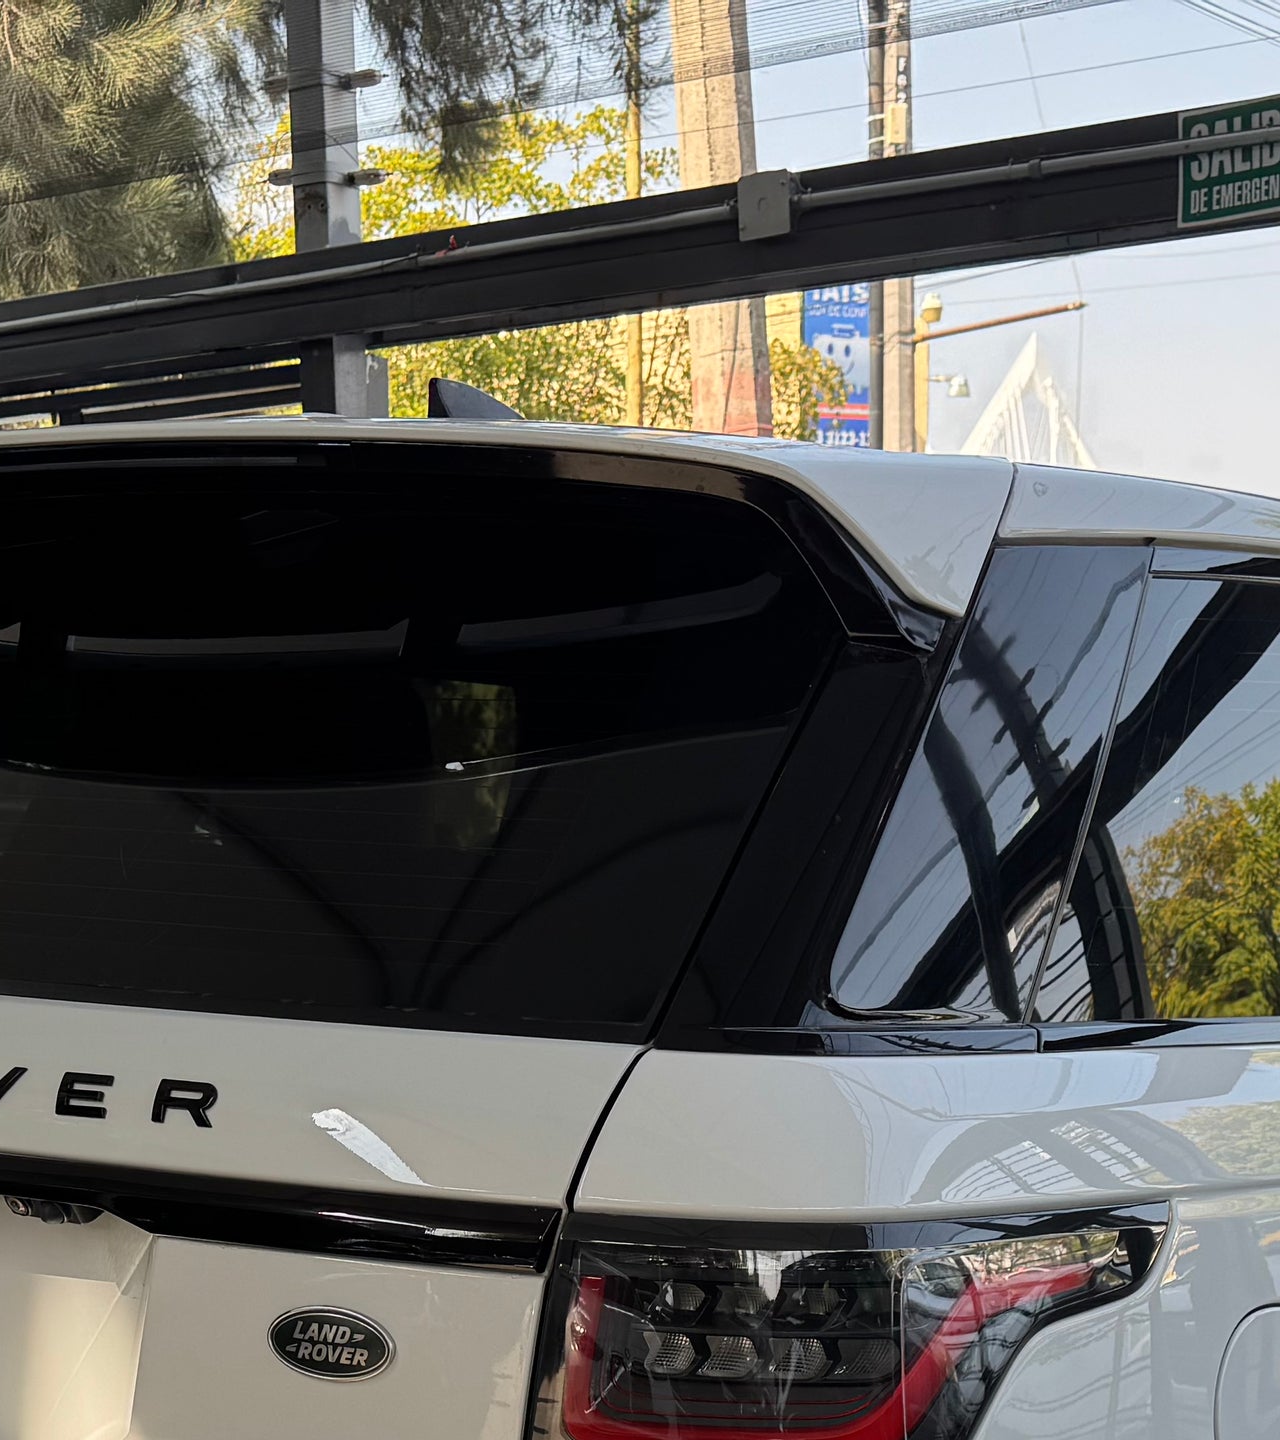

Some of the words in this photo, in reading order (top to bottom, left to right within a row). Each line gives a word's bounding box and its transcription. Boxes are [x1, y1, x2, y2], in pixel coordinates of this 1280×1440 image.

[1190, 188, 1208, 215] DE
[293, 1321, 351, 1344] LAND
[297, 1342, 369, 1367] ROVER
